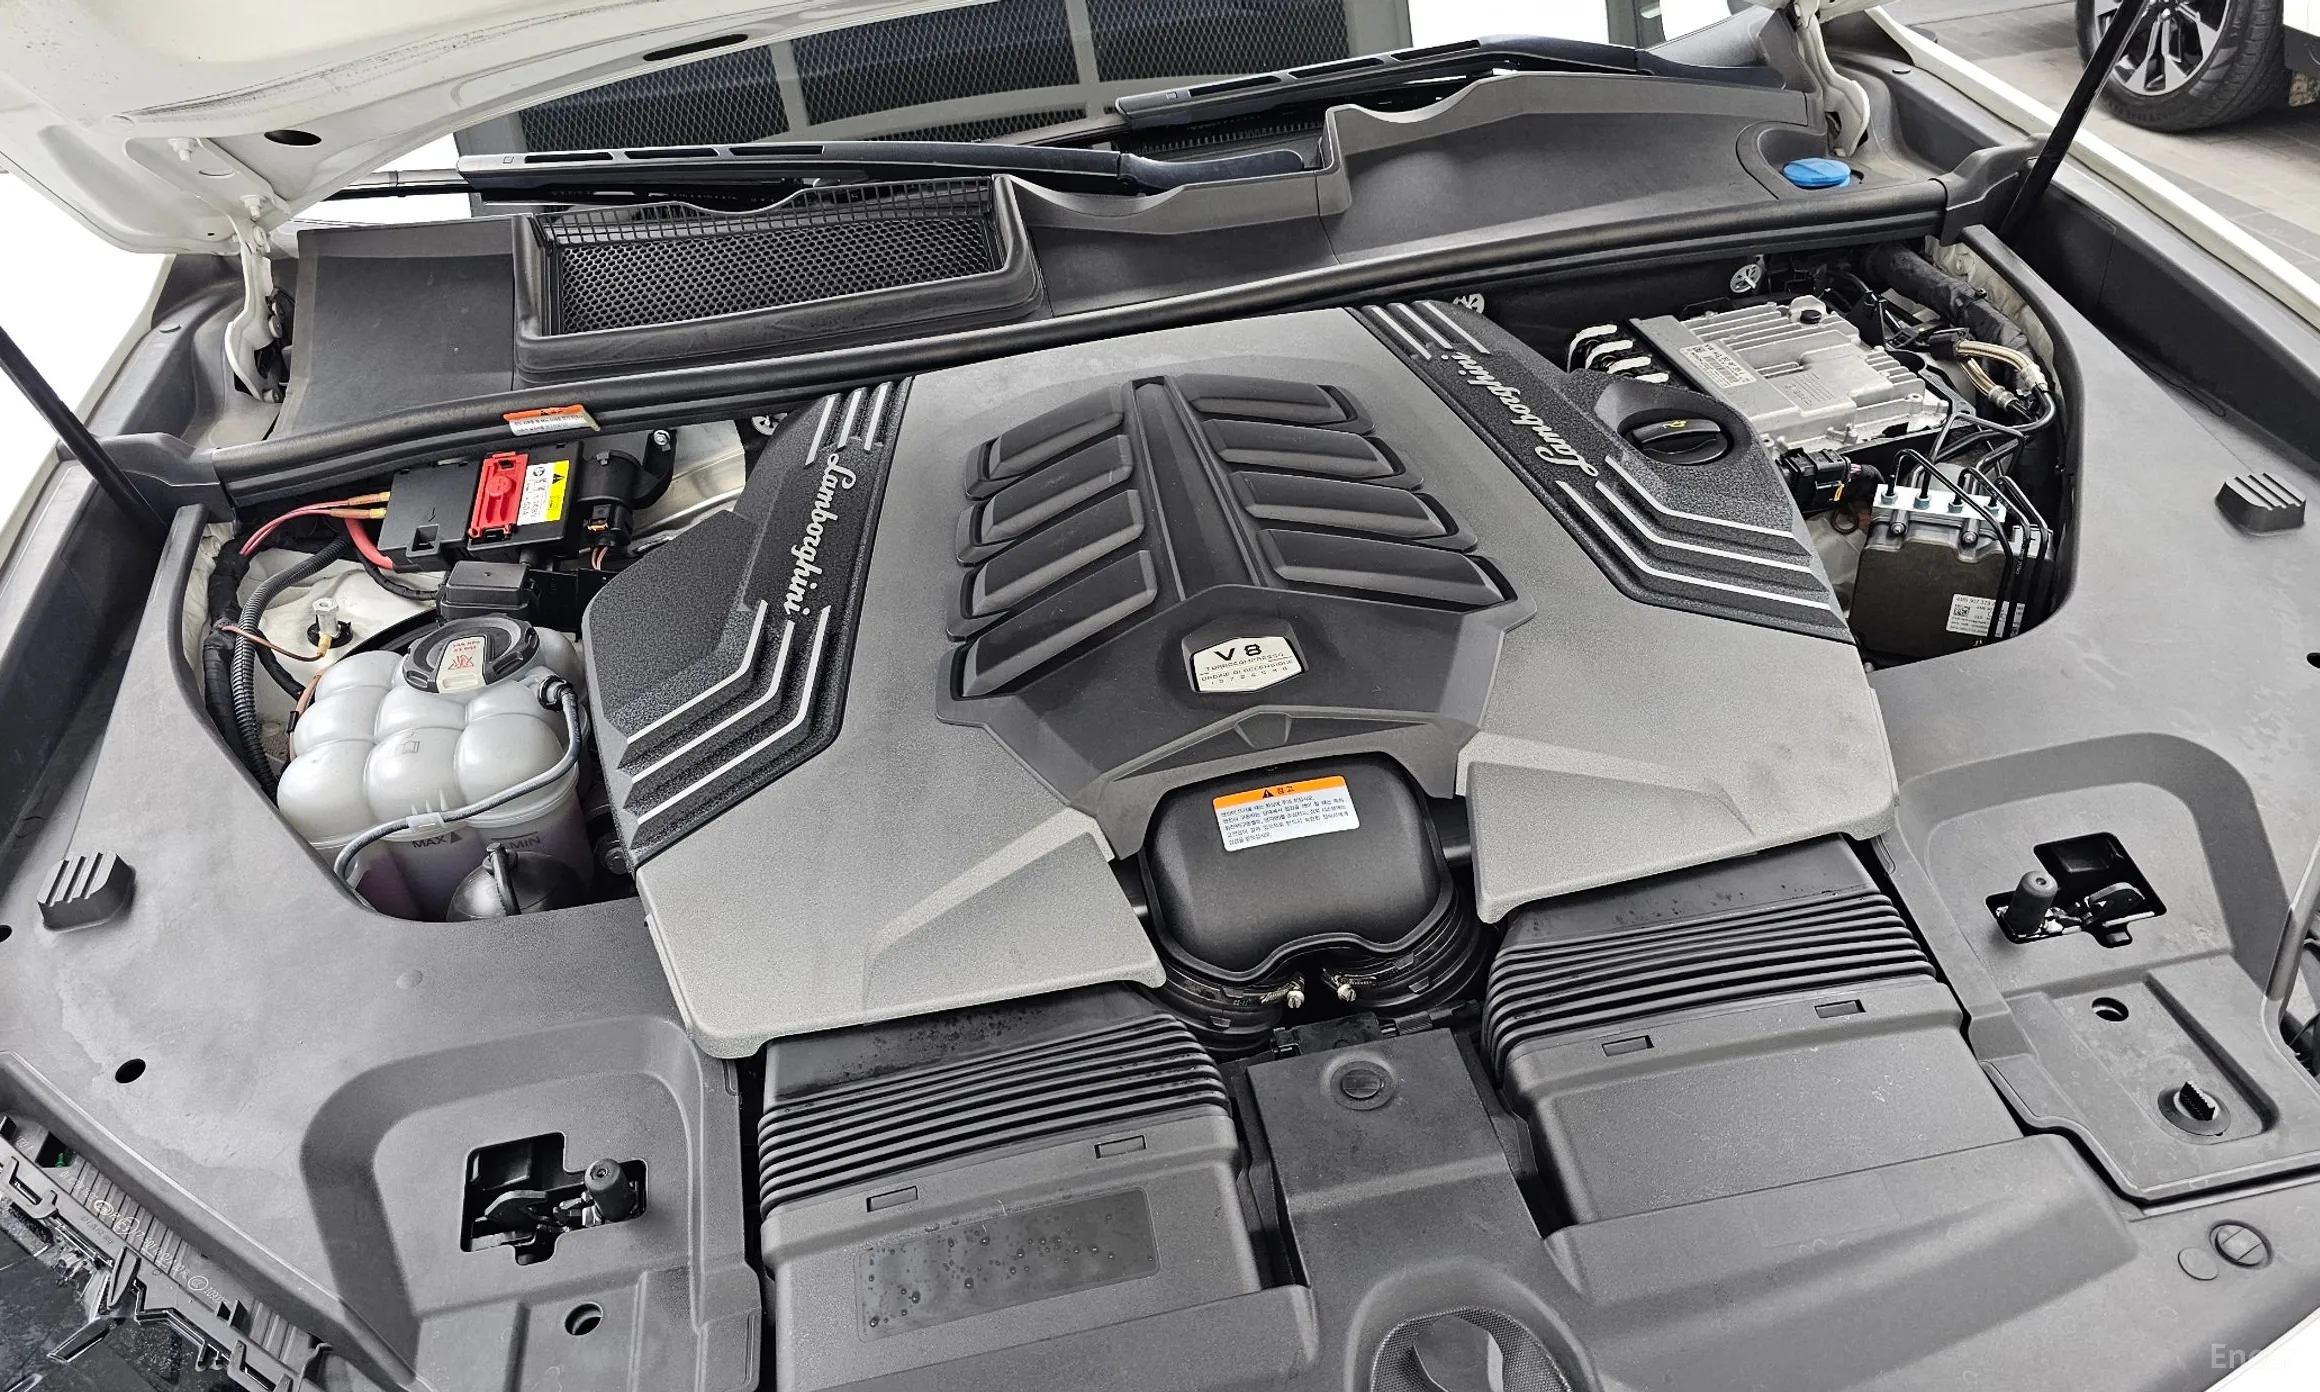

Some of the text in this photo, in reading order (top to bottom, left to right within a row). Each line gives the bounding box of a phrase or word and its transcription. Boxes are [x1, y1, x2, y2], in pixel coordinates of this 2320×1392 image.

[1441, 352, 1599, 477] Lamborghini
[784, 453, 856, 616] Lamborghini
[412, 835, 446, 848] MAX
[509, 835, 541, 849] MIN
